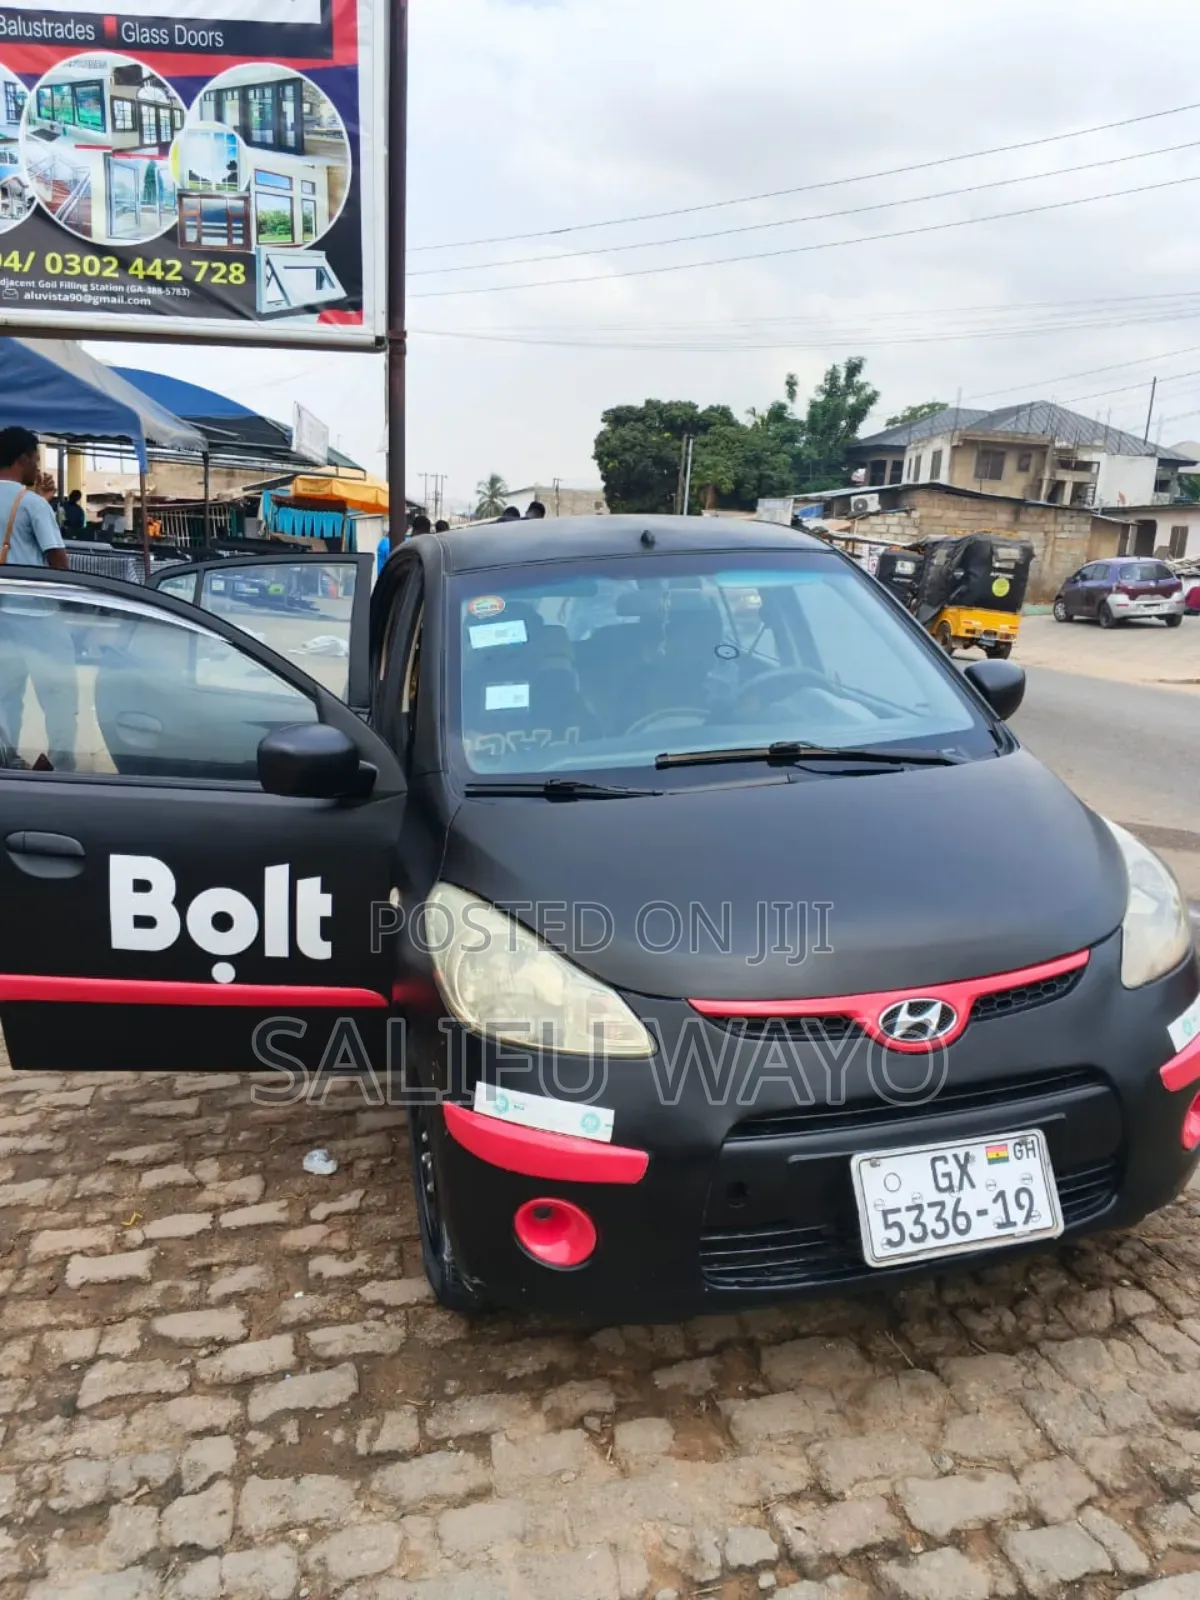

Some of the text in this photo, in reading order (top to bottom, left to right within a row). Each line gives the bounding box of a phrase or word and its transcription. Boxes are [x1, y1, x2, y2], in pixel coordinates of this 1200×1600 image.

[0, 14, 96, 41] Balustrades
[121, 21, 225, 47] Glass Doors
[0, 250, 246, 285] 4/ 0302 442 728
[23, 291, 152, 306] aluvista90@gmail.com
[59, 280, 89, 292] Filling
[89, 283, 125, 292] Station
[109, 853, 333, 984] Bolt
[930, 1139, 1037, 1193] GX GH
[881, 1187, 1035, 1248] 5336-19
